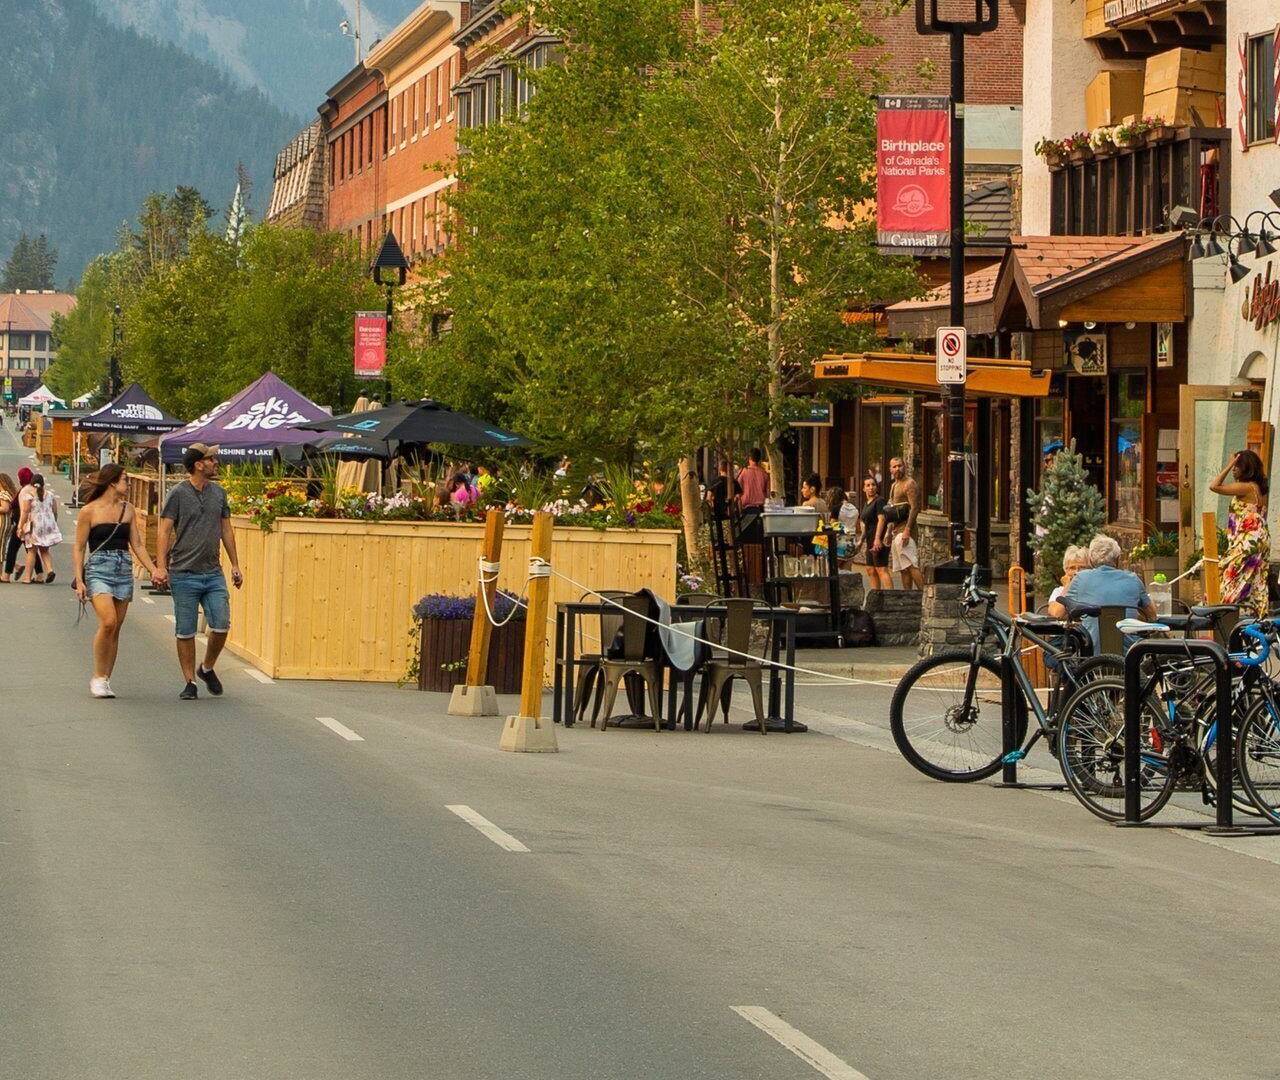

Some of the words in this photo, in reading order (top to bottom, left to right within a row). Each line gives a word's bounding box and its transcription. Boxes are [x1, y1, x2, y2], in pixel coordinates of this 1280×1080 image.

[881, 140, 945, 154] Birthplace
[885, 156, 895, 166] of
[896, 156, 940, 166] Canada's
[881, 166, 916, 176] National
[919, 166, 946, 176] Parks
[891, 234, 937, 247] Canada
